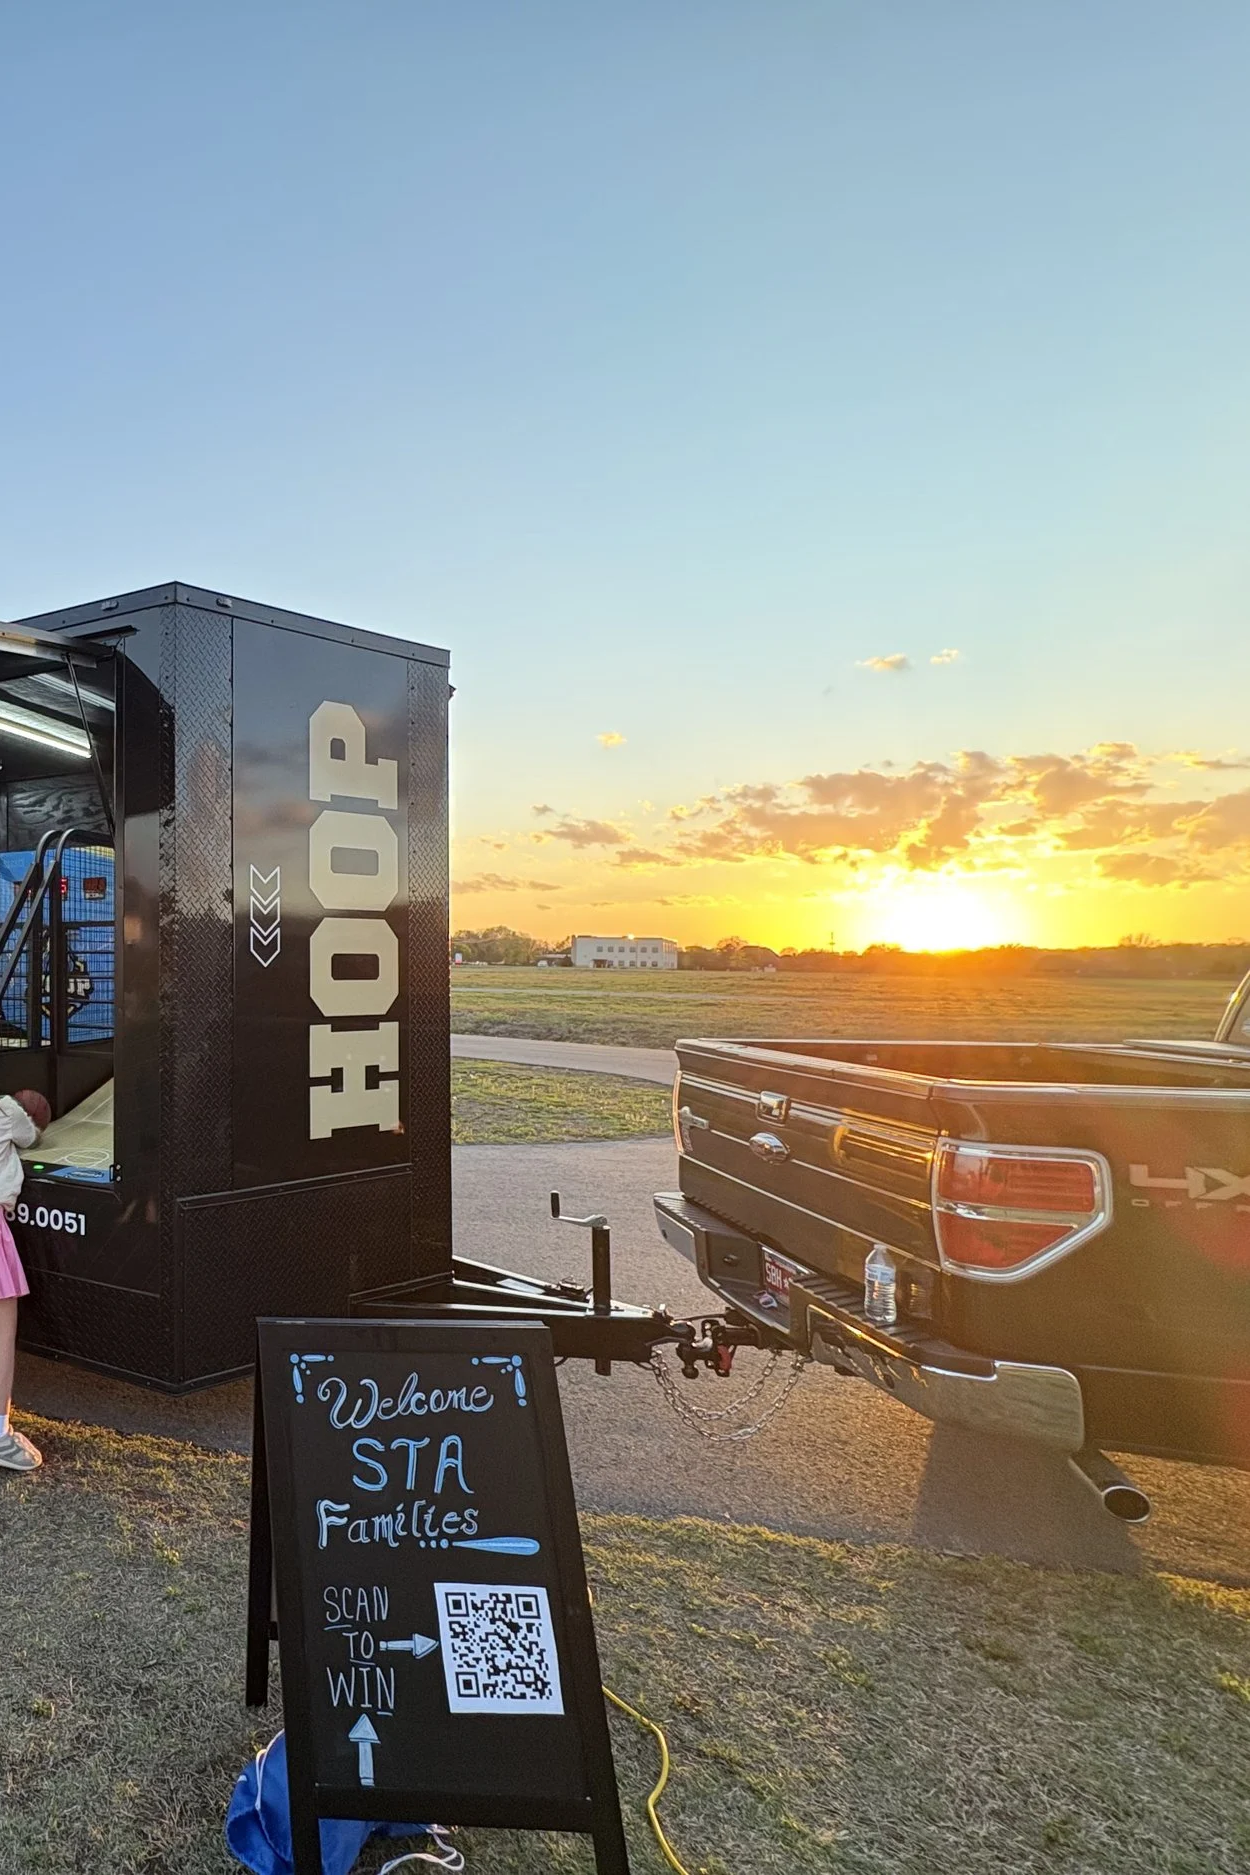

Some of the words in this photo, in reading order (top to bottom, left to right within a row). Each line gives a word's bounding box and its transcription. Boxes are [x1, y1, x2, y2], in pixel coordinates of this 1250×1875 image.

[309, 700, 399, 1139] HOOP
[317, 1372, 494, 1430] Welcome
[352, 1434, 474, 1494] STA
[316, 1499, 479, 1549] Families
[324, 1586, 389, 1624] SCAN
[343, 1632, 375, 1660] TO
[326, 1666, 395, 1710] WIN
